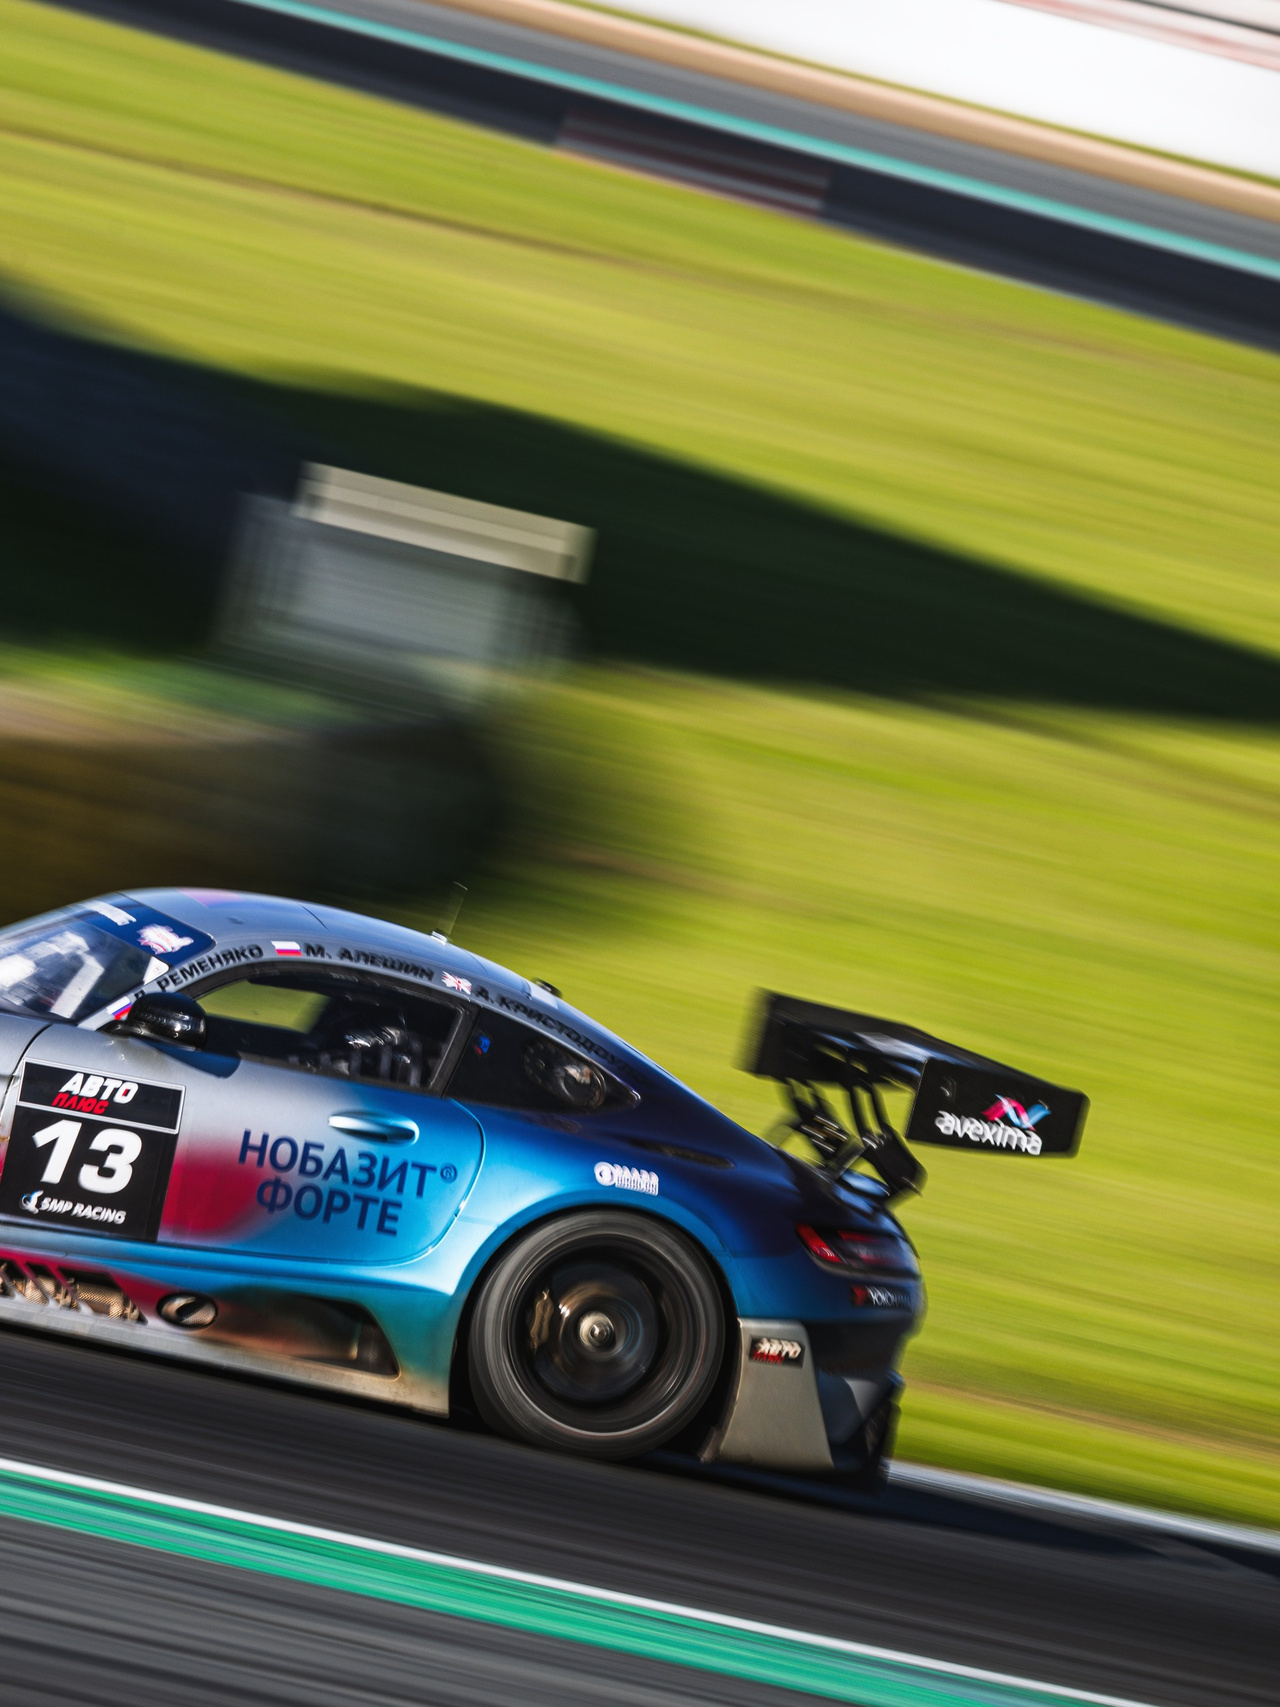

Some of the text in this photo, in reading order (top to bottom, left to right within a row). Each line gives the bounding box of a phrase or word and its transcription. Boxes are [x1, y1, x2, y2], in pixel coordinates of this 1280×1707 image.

[157, 943, 264, 993] РЕМЕНЯКО
[51, 1092, 109, 1115] ПЛЮС
[59, 1072, 139, 1104] АВТО
[934, 1110, 1042, 1156] avexima
[32, 1119, 143, 1194] 13
[40, 1197, 126, 1225] SMP RACING
[256, 1176, 403, 1237] ФОРТЕ
